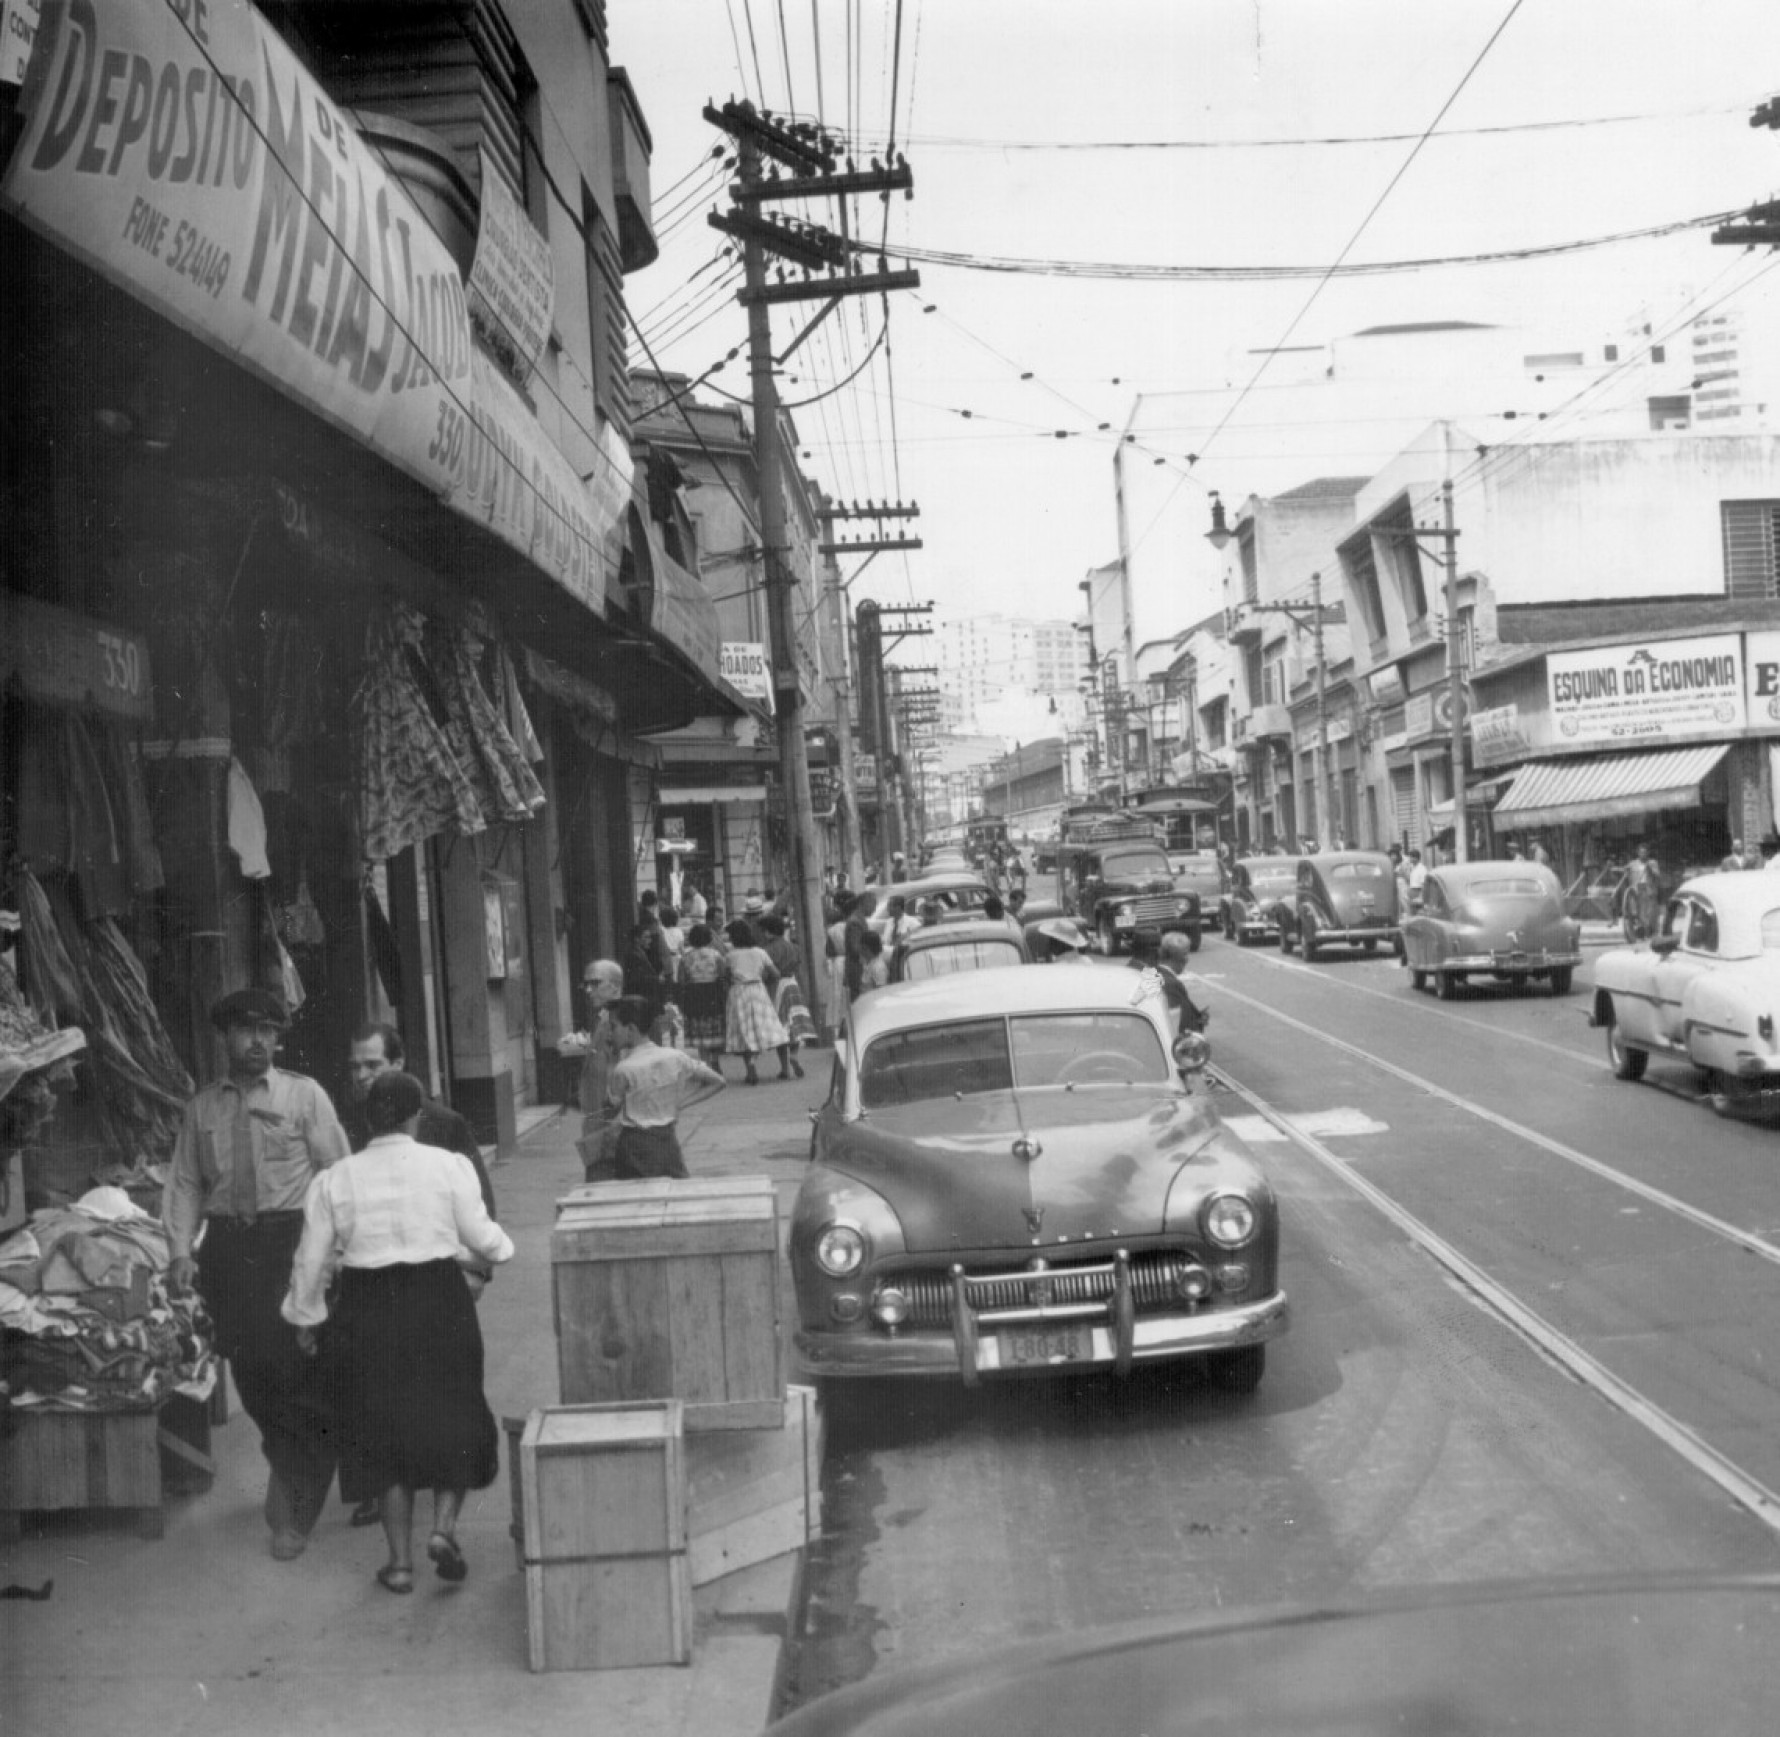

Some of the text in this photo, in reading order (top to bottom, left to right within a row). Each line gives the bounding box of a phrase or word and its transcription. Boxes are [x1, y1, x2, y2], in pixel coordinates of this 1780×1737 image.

[31, 0, 256, 190] DEPOSITO
[315, 96, 349, 163] DE
[122, 195, 170, 257] FONE
[241, 36, 396, 395] MEIAS
[428, 399, 465, 471] 330
[1553, 667, 1618, 704] ESQUINA
[1624, 669, 1645, 695] DA
[1650, 655, 1736, 693] ECONOMIA
